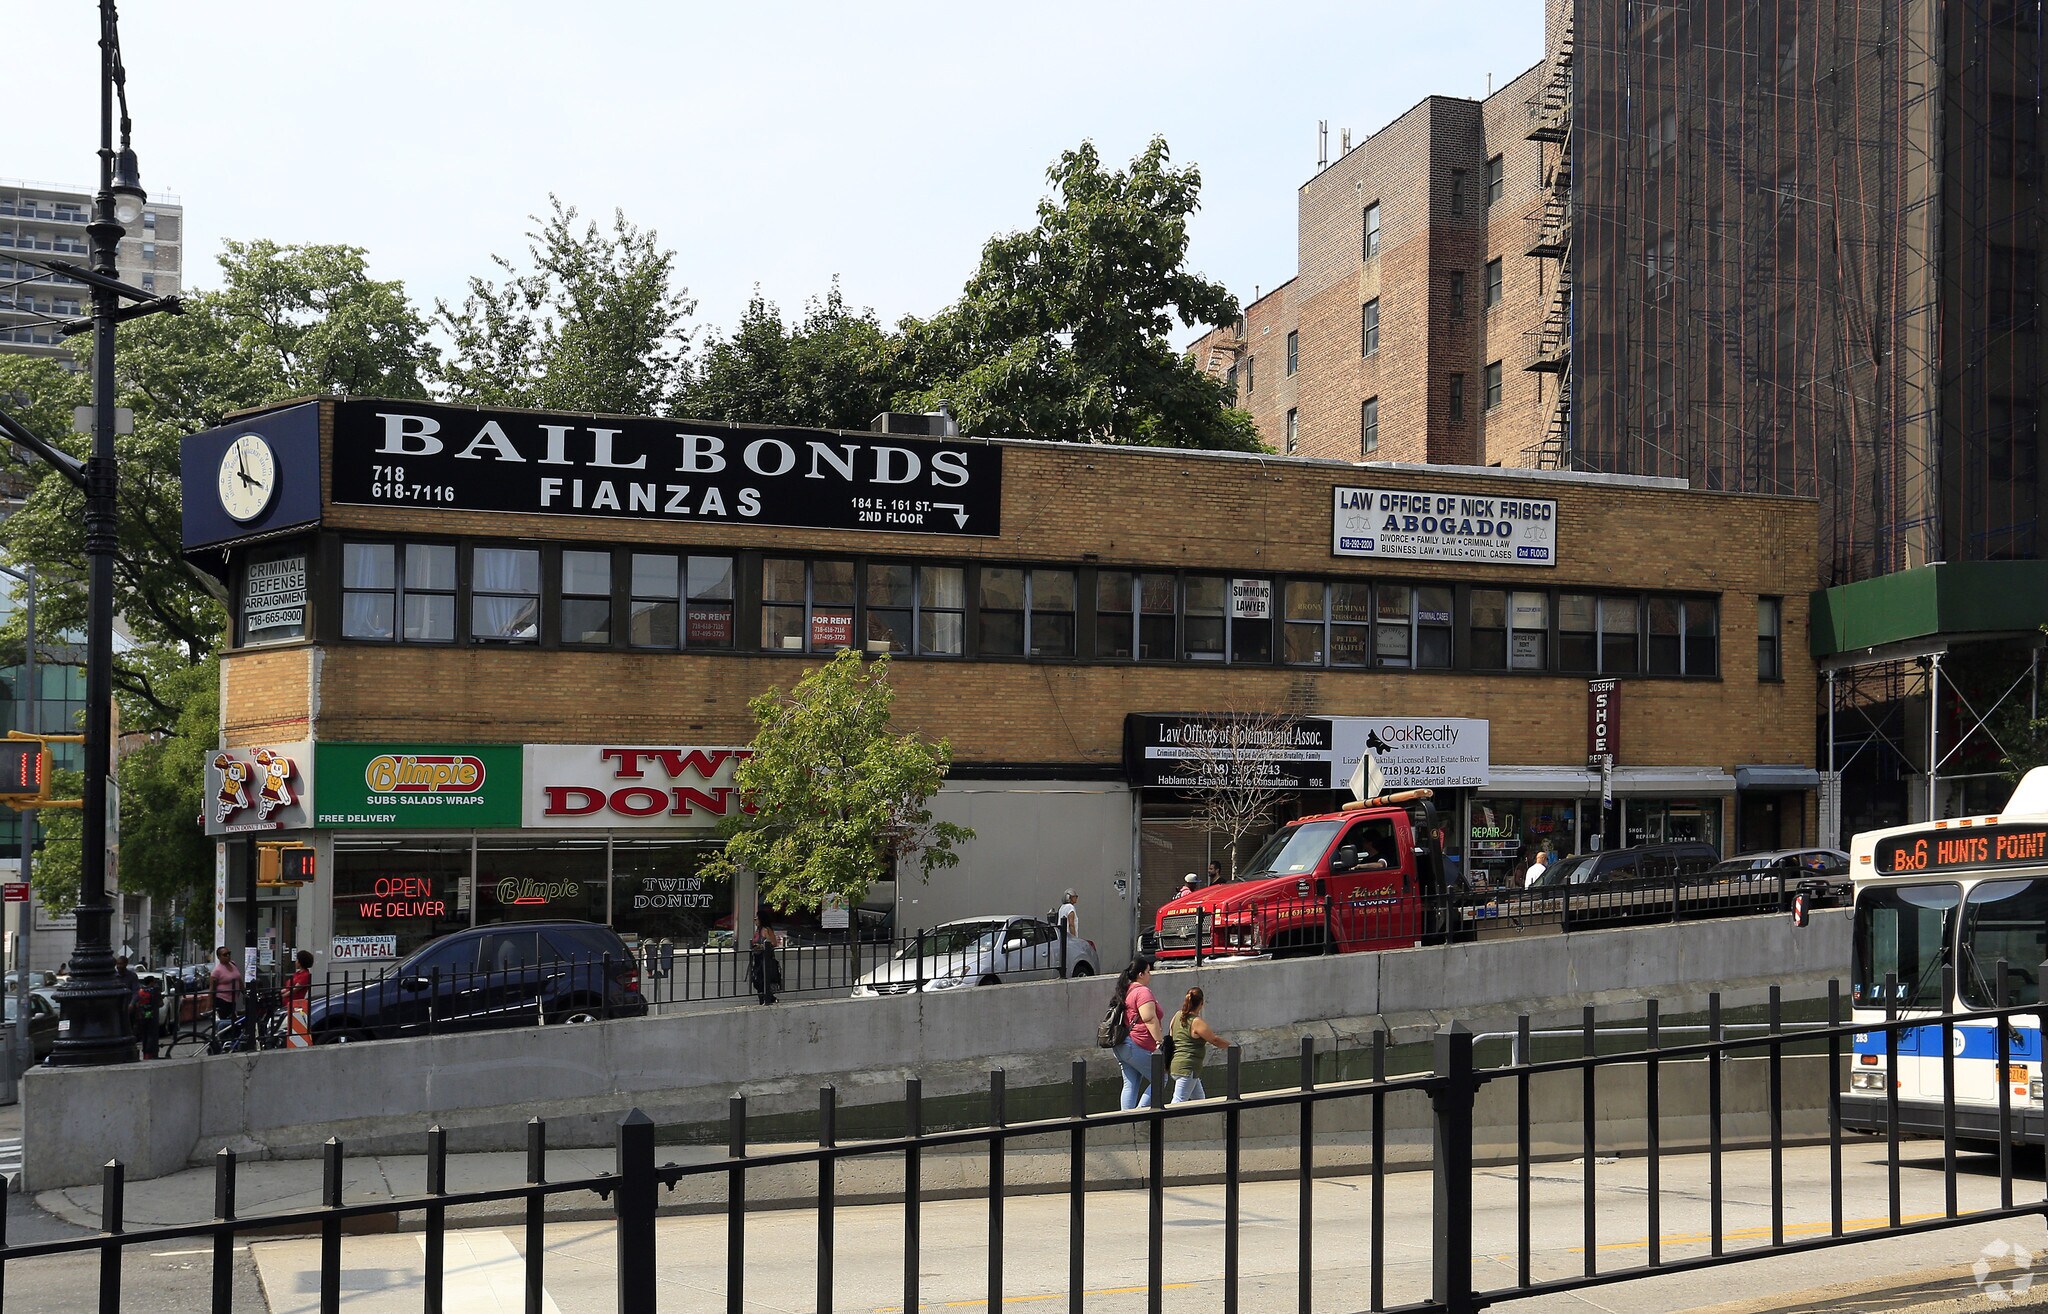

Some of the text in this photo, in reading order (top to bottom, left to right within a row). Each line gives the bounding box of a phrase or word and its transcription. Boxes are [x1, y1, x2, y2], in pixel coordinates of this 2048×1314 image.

[375, 412, 971, 488] BAIL BONDS
[372, 465, 405, 482] 718
[371, 482, 455, 502] 618-7116
[540, 477, 762, 517] FIANZAS
[851, 498, 932, 512] 184 E. 161 ST.
[1340, 490, 1552, 521] LAW OFFICE OF NICK FRISCO
[858, 510, 924, 525] 2ND FLOOR
[1382, 514, 1513, 538] ABOGADO
[1380, 534, 1511, 548] DIVORCE FAMILY LAW CRIMINAL LAW
[1381, 545, 1512, 559] BUSINESS LAW WILLS CIVIL CASES
[1518, 548, 1549, 558] 2nd FLOOR
[249, 558, 304, 578] CRIMINAL
[250, 573, 304, 594] DEFENSE
[245, 590, 307, 608] ARRAIGNMENT
[1233, 585, 1270, 598] SUMMONS
[1236, 600, 1266, 612] LAWYER
[249, 609, 301, 628] 718-665-0900
[689, 612, 732, 621] FOR RENT
[811, 616, 852, 625] FOR RENT
[1589, 682, 1615, 692] JOSEPH
[1595, 694, 1607, 752] SHOE
[1159, 723, 1181, 743] Law
[1183, 724, 1218, 744] Offices
[1219, 725, 1230, 744] of
[1294, 727, 1323, 746] Assoc.
[1381, 724, 1460, 745] OakRealty
[1397, 756, 1424, 764] Licensed
[1425, 756, 1440, 764] Real
[1440, 755, 1459, 763] Estate
[1459, 755, 1480, 764] Broker
[20, 751, 42, 787] 11
[366, 755, 476, 792] Blimpie
[1403, 765, 1446, 775] 942-4216
[1158, 775, 1197, 785] Hablamos
[1403, 777, 1410, 786] &
[1411, 776, 1446, 786] Residential
[1447, 776, 1461, 785] Real
[1462, 775, 1482, 785] Estate
[366, 796, 485, 805] SUBS SALADS WRAPS
[319, 814, 396, 823] FREE DELIVERY
[1471, 826, 1500, 838] REPAIR
[1894, 832, 2047, 871] Bx6 HUNTS POINT
[301, 855, 315, 875] 11
[374, 877, 432, 898] OPEN
[642, 877, 702, 892] TWIN
[633, 894, 714, 909] DONUT
[359, 901, 445, 918] WE DELIVER
[375, 935, 395, 943] DAILY
[334, 943, 394, 958] OATMEAL
